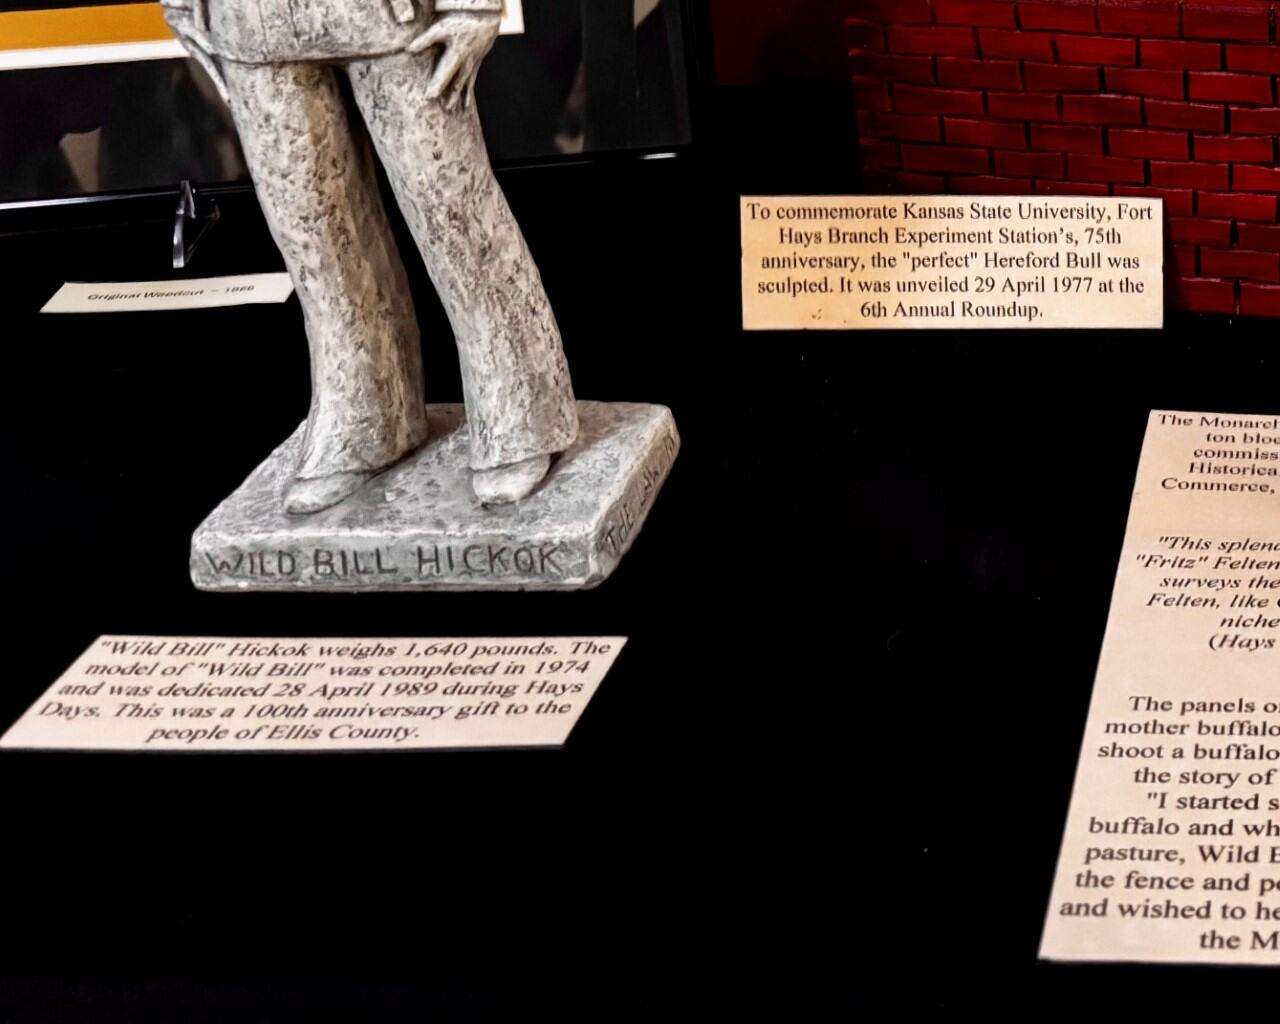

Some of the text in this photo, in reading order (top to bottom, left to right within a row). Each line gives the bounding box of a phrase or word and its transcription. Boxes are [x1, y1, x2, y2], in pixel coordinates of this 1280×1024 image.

[745, 201, 1152, 224] To commemorate Kansas State University, Fort
[778, 226, 822, 249] Hays
[827, 225, 889, 244] Branch
[894, 225, 992, 249] Experiment
[1083, 226, 1121, 245] 75th
[760, 249, 1140, 273] anniversary, the "perfect" Hereford Bull was
[756, 274, 1145, 298] sculpted. It was unveiled 29 April 1977 at the
[859, 299, 1043, 322] 6th Annual Roundup.
[204, 542, 561, 576] WILD BILL HICKOK
[101, 639, 611, 660] "Wild Bill" Hickok weighs 1,640 pounds. The
[1207, 633, 1276, 652] (Hays
[84, 659, 590, 680] model of "Wild Bill" was completed in 1974
[57, 679, 584, 701] and was dedicated 28 April 1989 during Hays
[38, 699, 572, 720] Days. This was a 100th anniversary gift to the
[1127, 695, 1173, 712] The
[1179, 696, 1256, 716] panels
[144, 723, 419, 743] people of Ellis County.
[1103, 718, 1190, 735] mother
[1133, 765, 1171, 784] the
[1177, 769, 1240, 789] story
[1246, 767, 1278, 786] of
[1146, 791, 1167, 809] "I
[1175, 792, 1260, 811] started
[1088, 815, 1180, 835] buffalo
[1186, 817, 1234, 836] and
[1083, 845, 1185, 865] pasture,
[1197, 843, 1260, 864] Wild
[1058, 897, 1109, 917] and
[1117, 897, 1212, 919] wished
[1220, 903, 1247, 920] to
[1199, 928, 1241, 950] the
